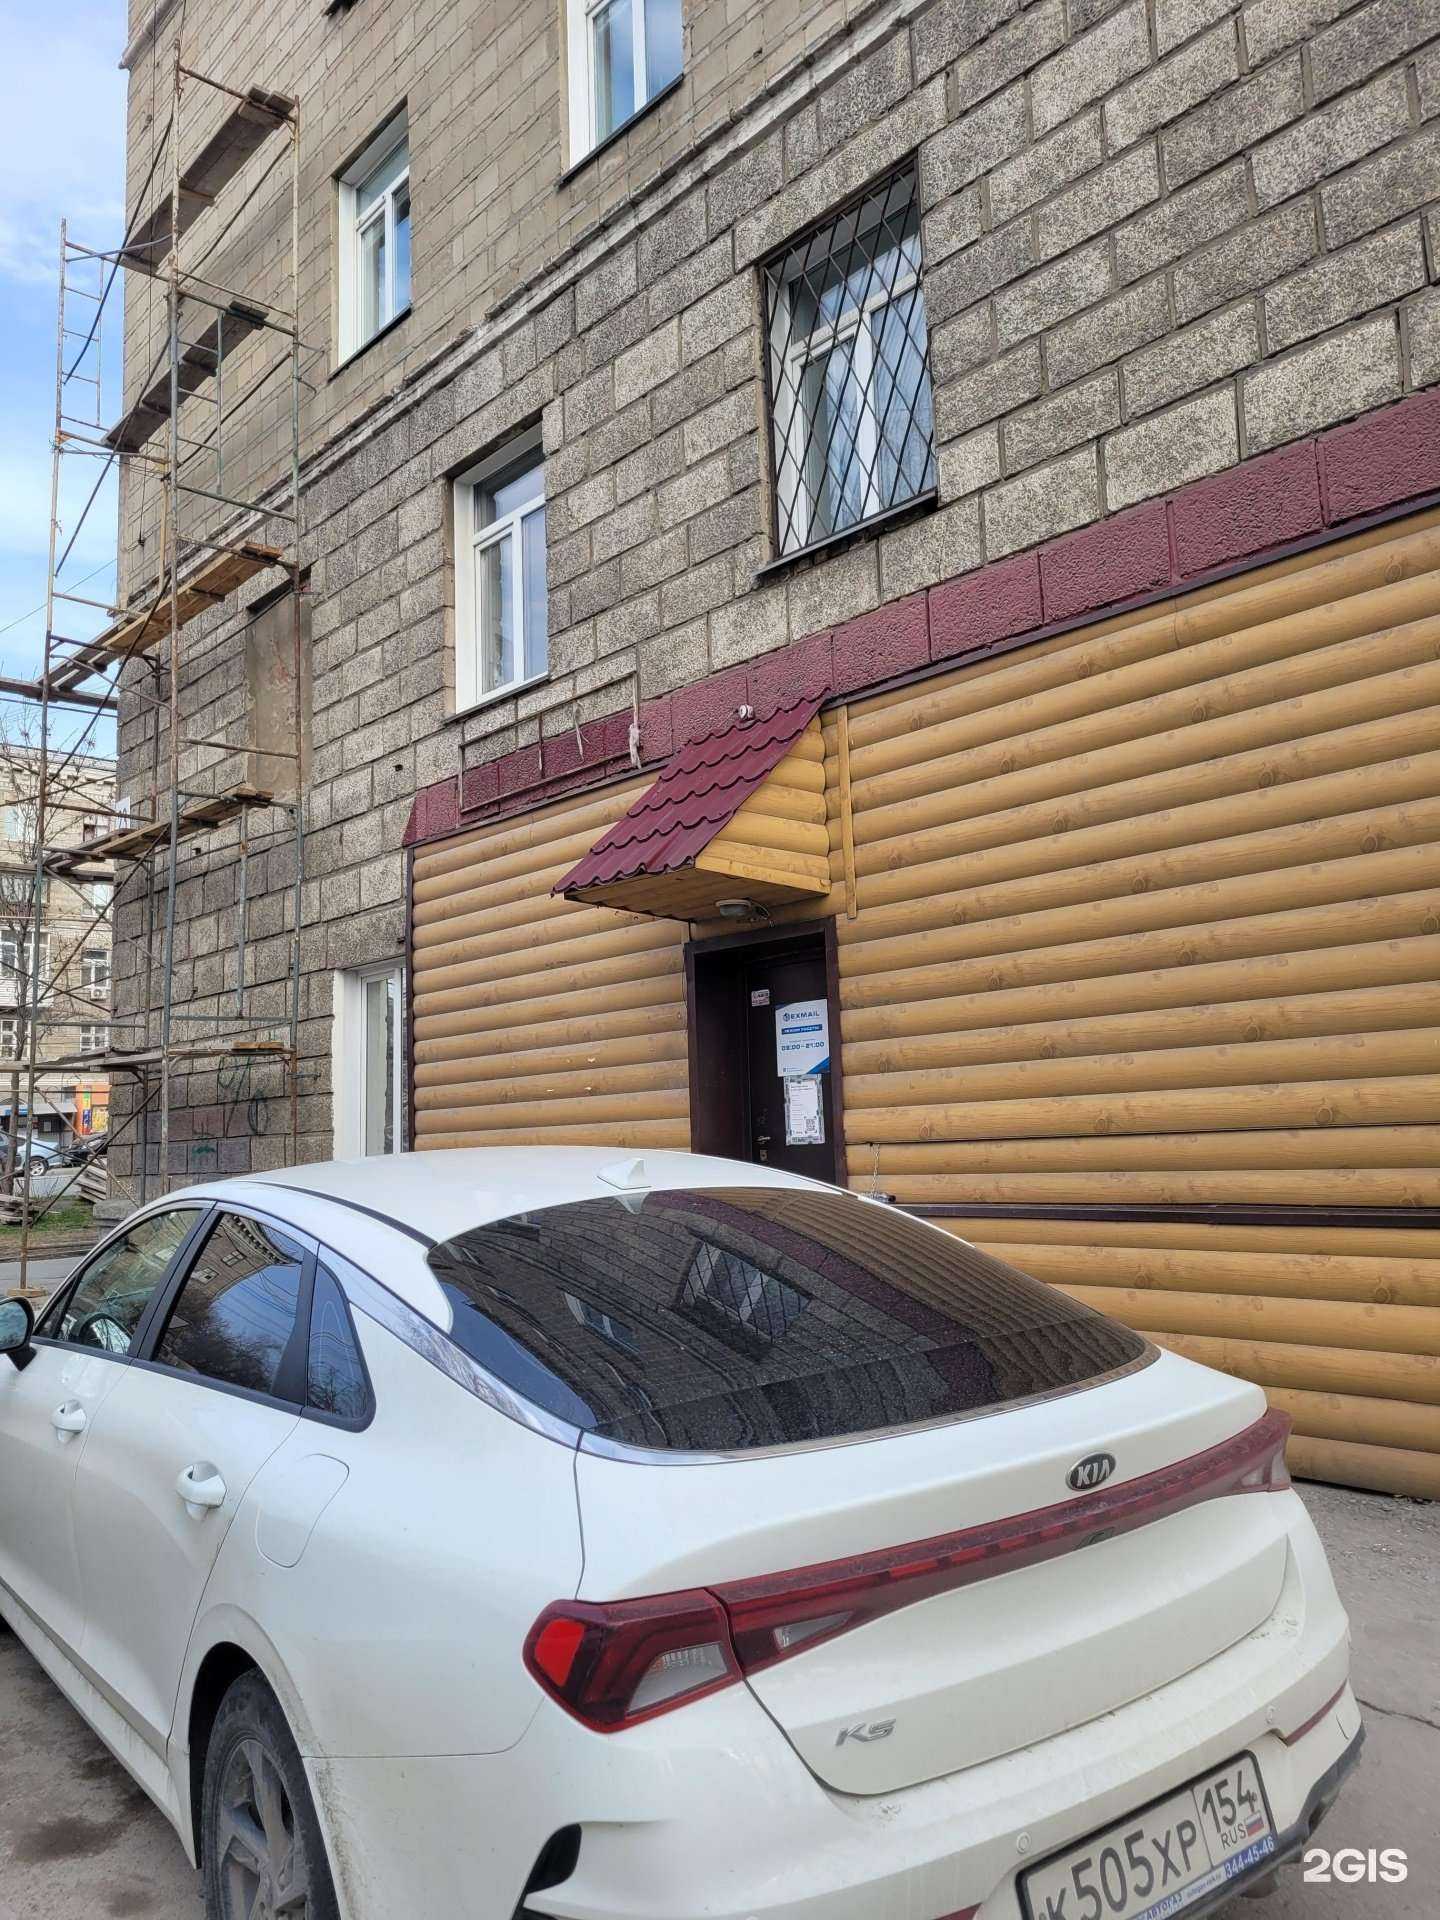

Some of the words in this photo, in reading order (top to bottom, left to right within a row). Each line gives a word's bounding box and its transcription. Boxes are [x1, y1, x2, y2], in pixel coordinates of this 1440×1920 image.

[790, 1010, 820, 1020] EXMAIL
[835, 1718, 897, 1747] K5
[1201, 1770, 1258, 1834] 154
[1220, 1824, 1247, 1851] RUS
[1225, 1836, 1275, 1879] 344-45-46
